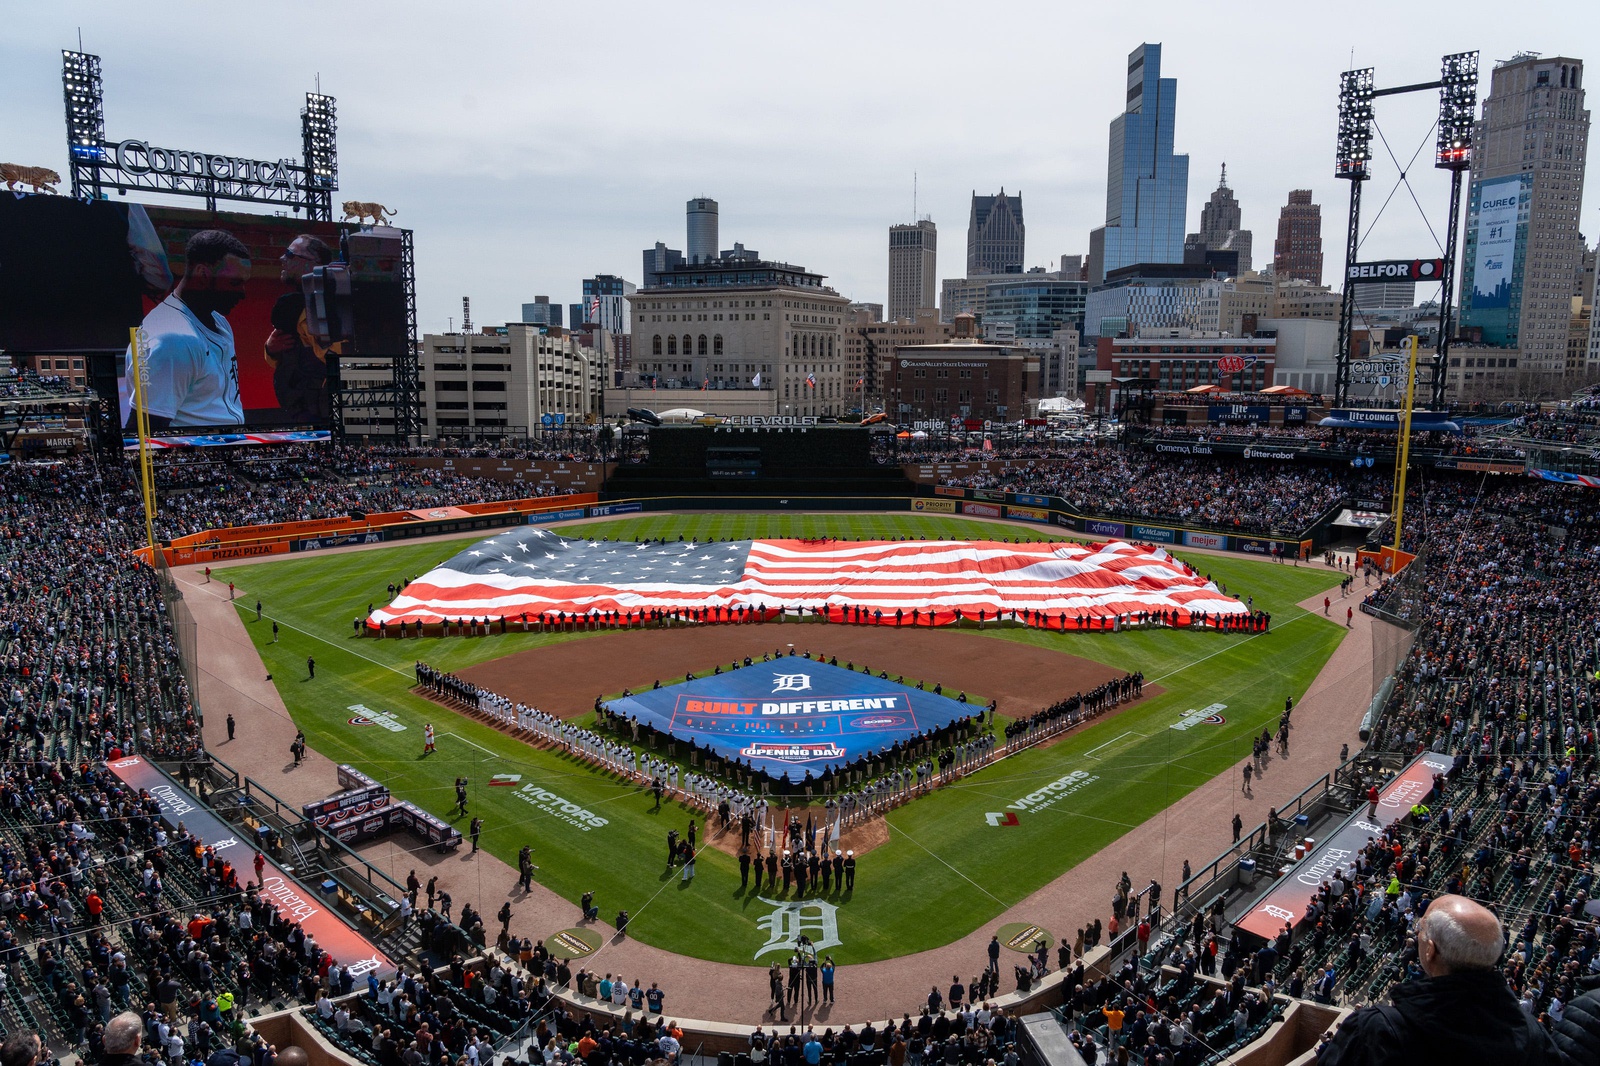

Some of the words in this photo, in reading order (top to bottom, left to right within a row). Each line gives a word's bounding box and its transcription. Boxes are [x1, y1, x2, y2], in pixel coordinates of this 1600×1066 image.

[172, 176, 253, 198] PARK
[1482, 198, 1507, 209] CURE
[1490, 226, 1502, 238] #1
[1350, 264, 1408, 278] BELFOR
[1218, 357, 1245, 371] AAA
[1231, 405, 1248, 415] Lite
[1350, 411, 1364, 422] Lite
[1365, 412, 1394, 421] LOUNGE
[731, 416, 820, 426] CHEVROLET
[913, 418, 945, 431] meijer
[46, 437, 76, 447] MARKET
[1192, 445, 1212, 455] Bank
[1251, 449, 1294, 459] litter-robot
[592, 507, 610, 516] DTE
[1357, 501, 1384, 509] PEPSI
[1092, 522, 1119, 535] xfinity
[1145, 528, 1170, 537] McLaren
[1191, 535, 1217, 546] meijer
[212, 549, 242, 559] PIZZA!
[244, 545, 273, 556] PIZZA!
[686, 700, 758, 715] BUILT
[762, 697, 898, 715] DIFFERENT
[1006, 770, 1090, 810] VICTORS
[1028, 799, 1056, 814] HOME
[1054, 775, 1101, 800] SOLUTIONS
[1404, 789, 1423, 804] PARK
[323, 801, 339, 812] BUILT
[340, 792, 370, 807] DIFFERENT
[521, 783, 609, 828] VICTORS
[511, 790, 538, 805] HOME
[537, 803, 592, 832] SOLUTIONS
